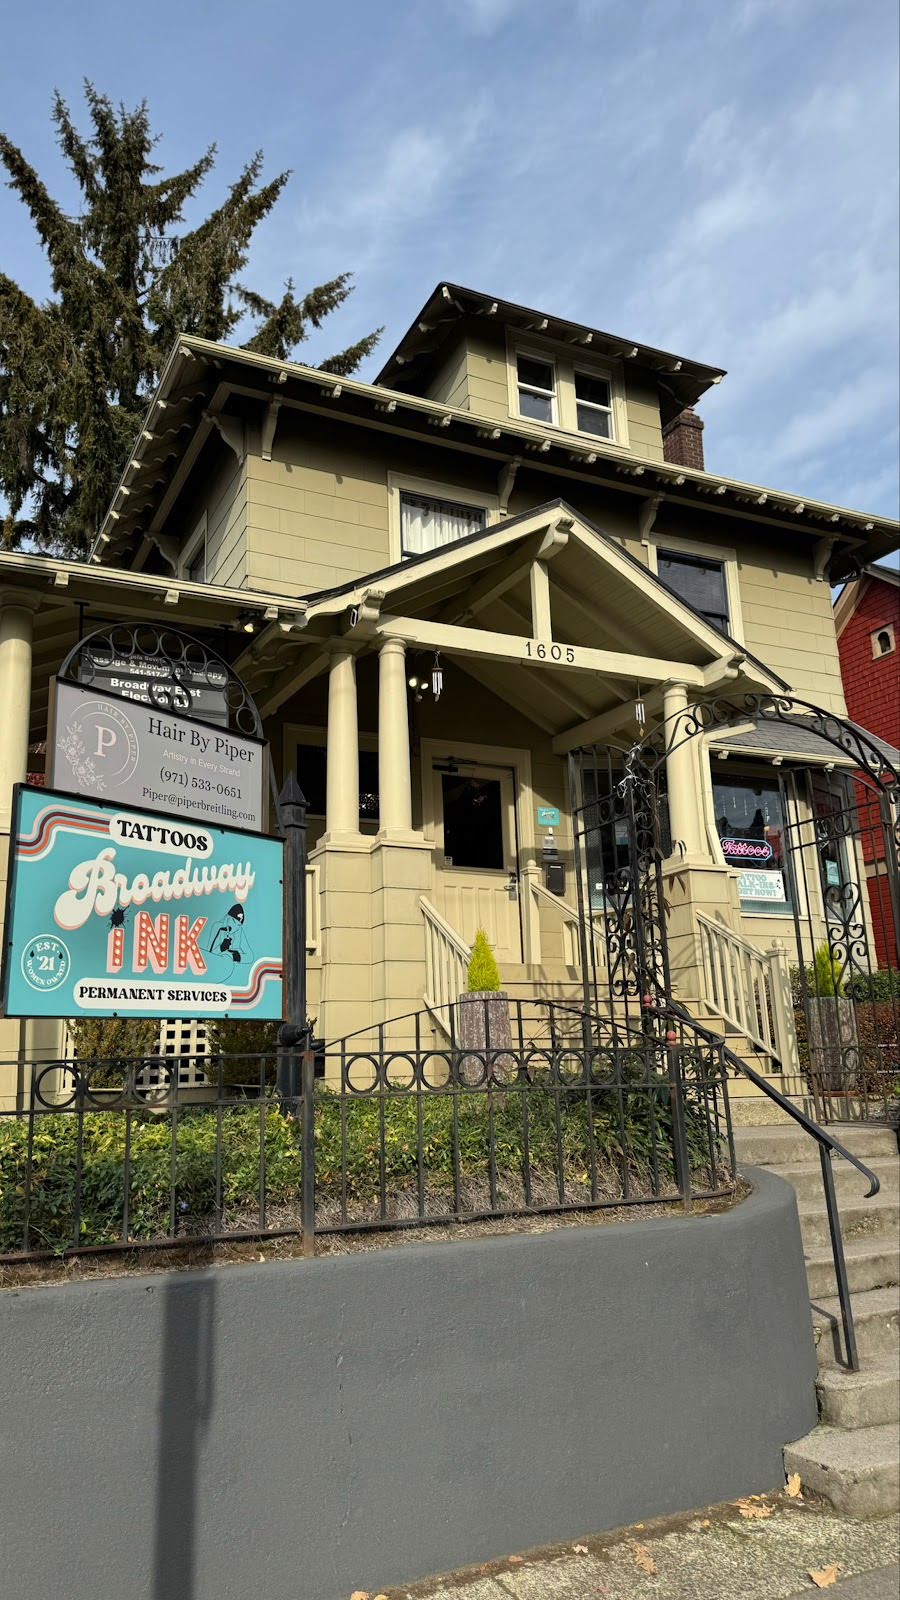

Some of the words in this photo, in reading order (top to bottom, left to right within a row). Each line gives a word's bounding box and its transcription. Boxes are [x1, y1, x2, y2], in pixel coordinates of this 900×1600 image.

[525, 641, 575, 663] 1605
[129, 660, 137, 668] &
[139, 660, 185, 674] Movemnt
[93, 724, 117, 757] P
[148, 716, 186, 743] Hair
[190, 729, 210, 753] By
[214, 736, 255, 763] Piper
[162, 749, 189, 765] Artistry
[190, 756, 197, 765] in
[198, 758, 218, 773] Every
[219, 763, 241, 777] Strand
[160, 766, 189, 788] (971)
[191, 777, 242, 799] 533-0651
[142, 787, 256, 822] Piper@piperbreitling.com
[117, 820, 208, 851] TATTOOS
[54, 847, 256, 930] Broadway
[740, 873, 767, 881] ATTOO
[35, 941, 60, 953] EST.
[79, 986, 165, 1001] PERMANENT
[167, 988, 228, 1003] SERVICES
